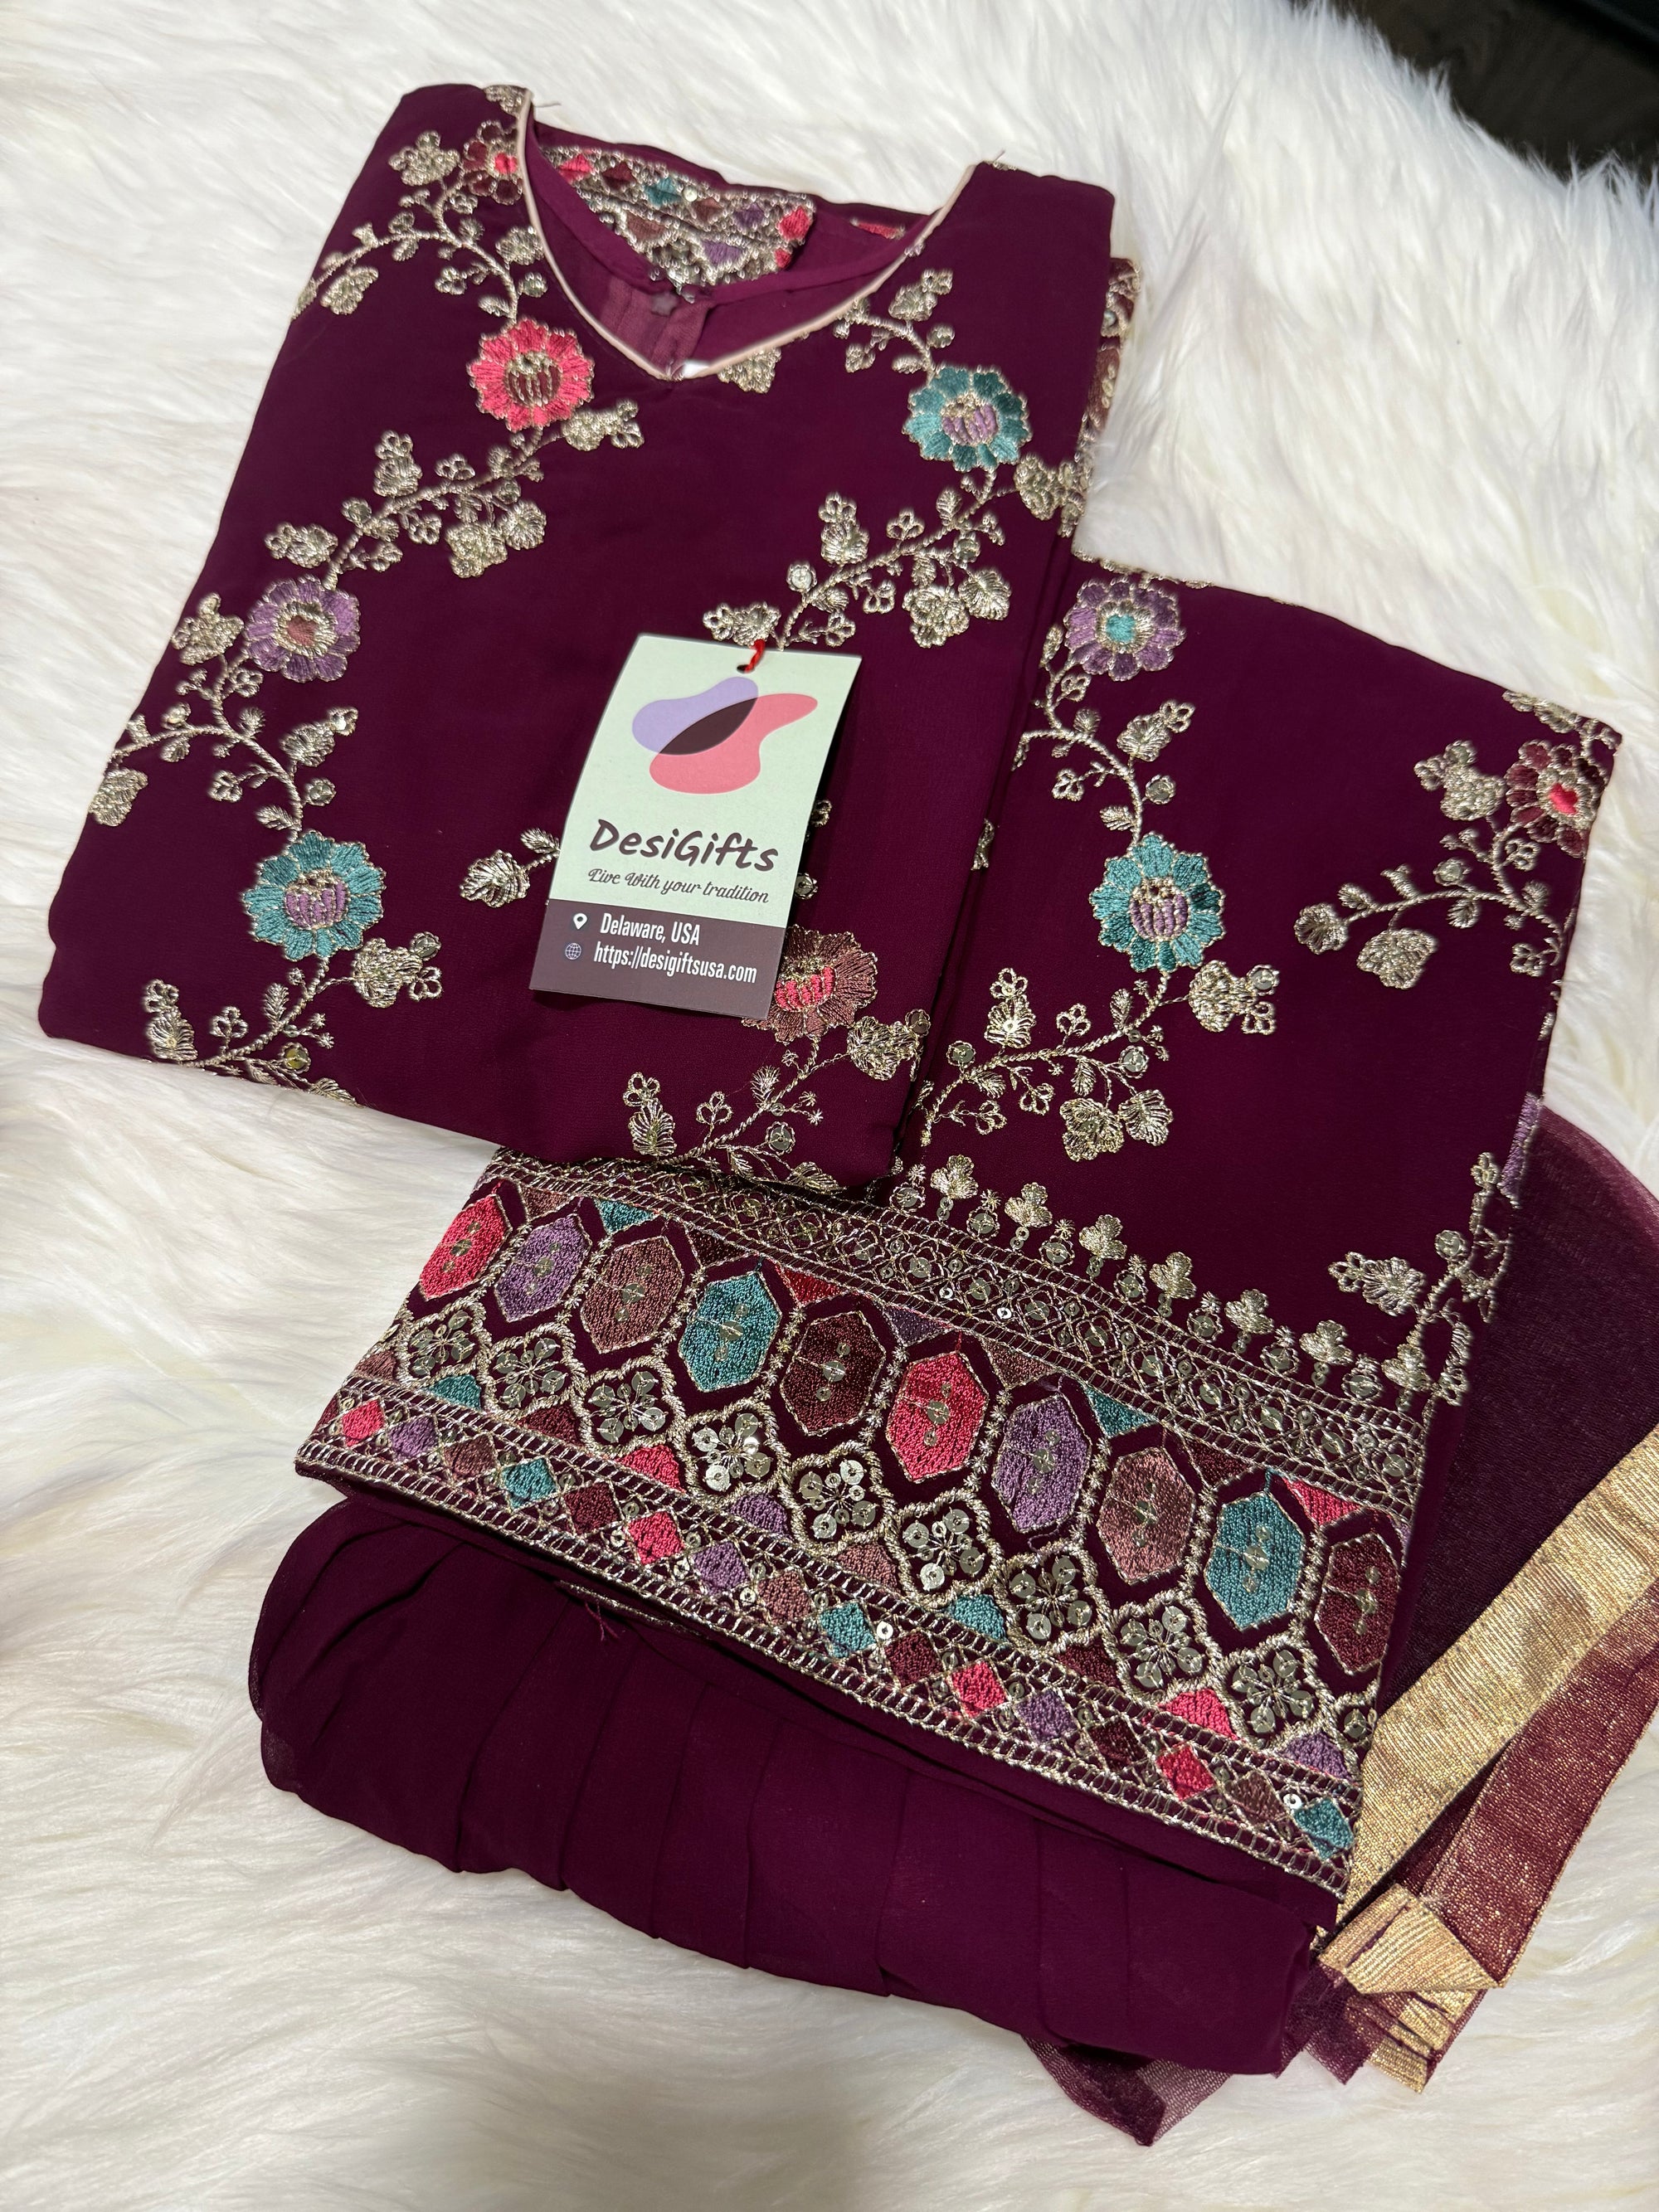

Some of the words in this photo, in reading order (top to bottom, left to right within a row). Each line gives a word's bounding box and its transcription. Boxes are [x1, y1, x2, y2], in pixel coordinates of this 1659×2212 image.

[589, 818, 779, 872] DesiGifts
[587, 868, 621, 886] Live
[625, 872, 660, 890] With
[661, 879, 702, 895] your
[703, 880, 769, 904] tradition
[600, 912, 666, 943] Delaware,
[671, 921, 701, 946] USA
[594, 941, 758, 984] https://desigiftsusa.com
